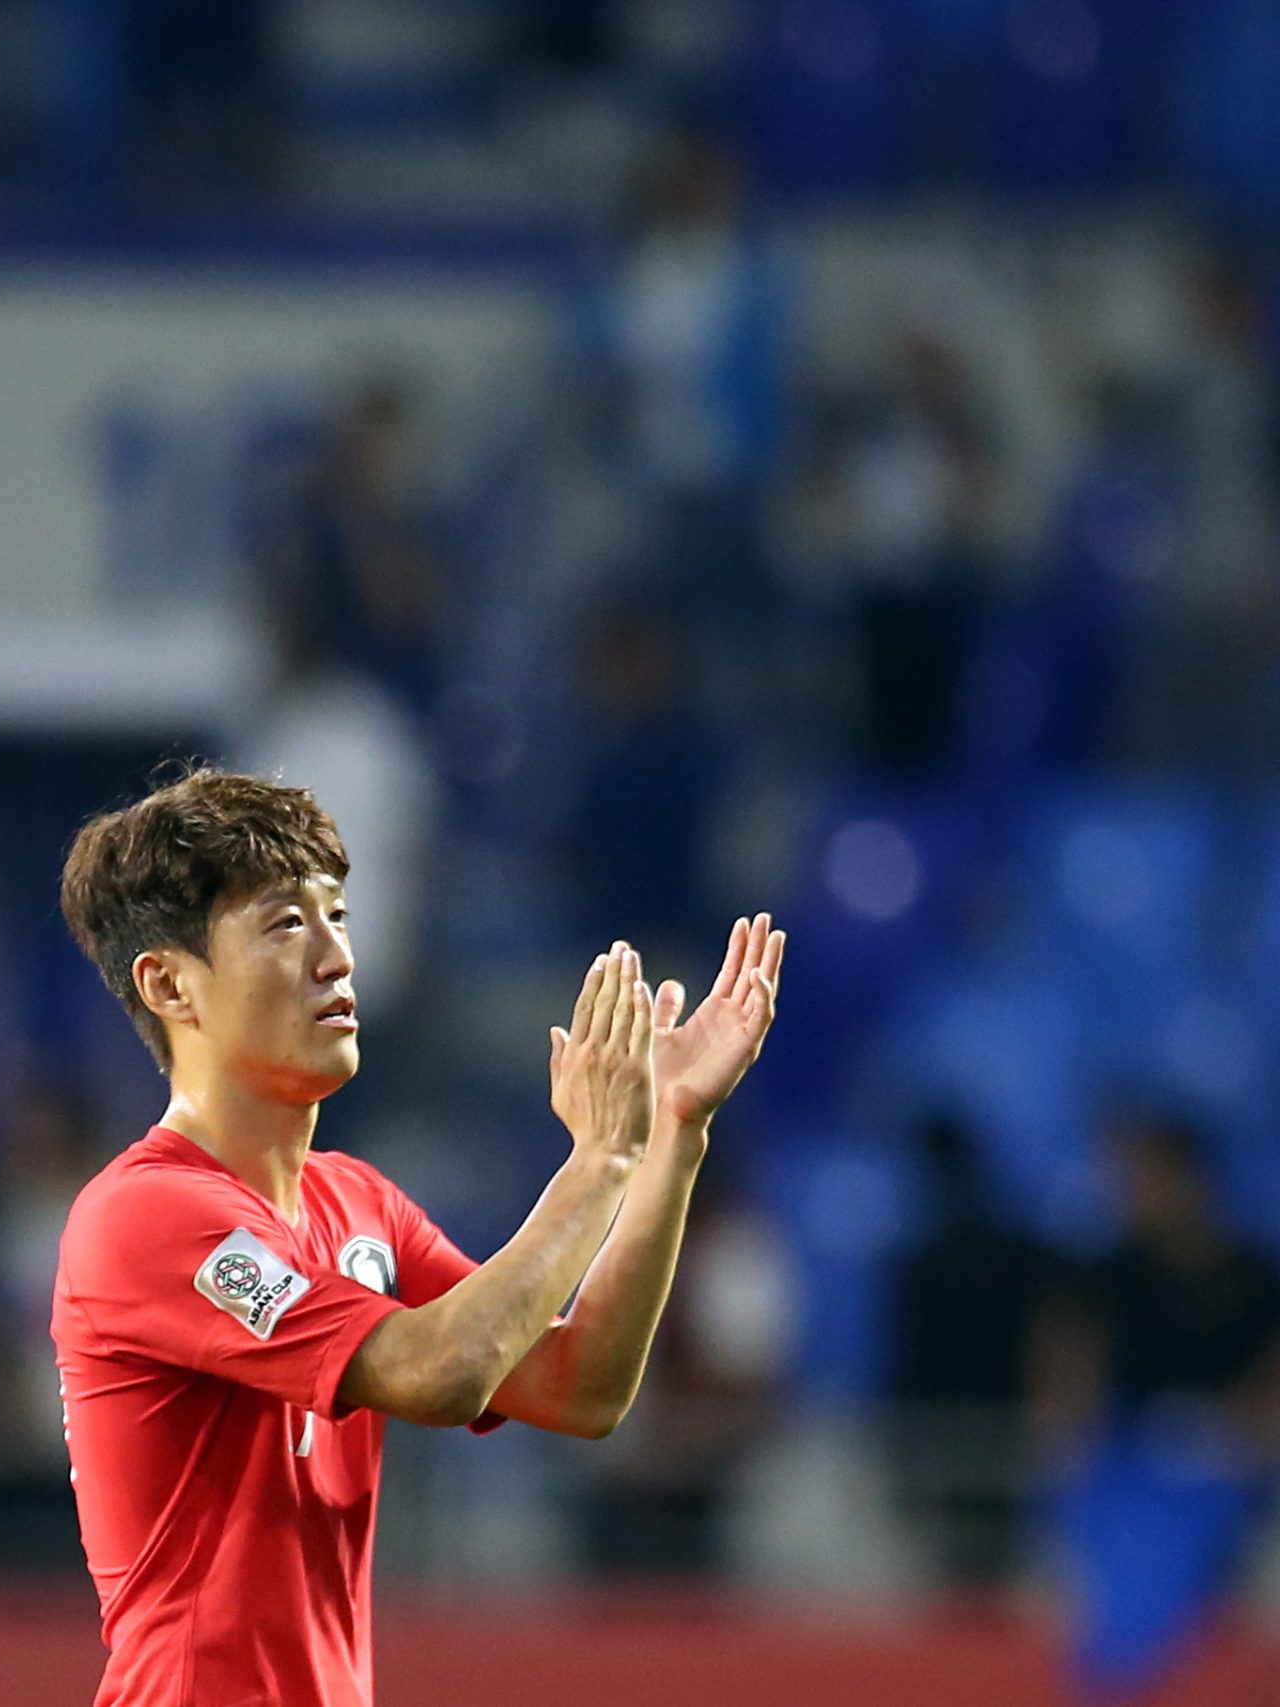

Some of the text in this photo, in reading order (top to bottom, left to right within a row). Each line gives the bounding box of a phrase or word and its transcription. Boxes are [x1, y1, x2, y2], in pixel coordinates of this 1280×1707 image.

[249, 1294, 273, 1326] ASIAN
[271, 1275, 293, 1295] CUP
[251, 1284, 270, 1302] AFC
